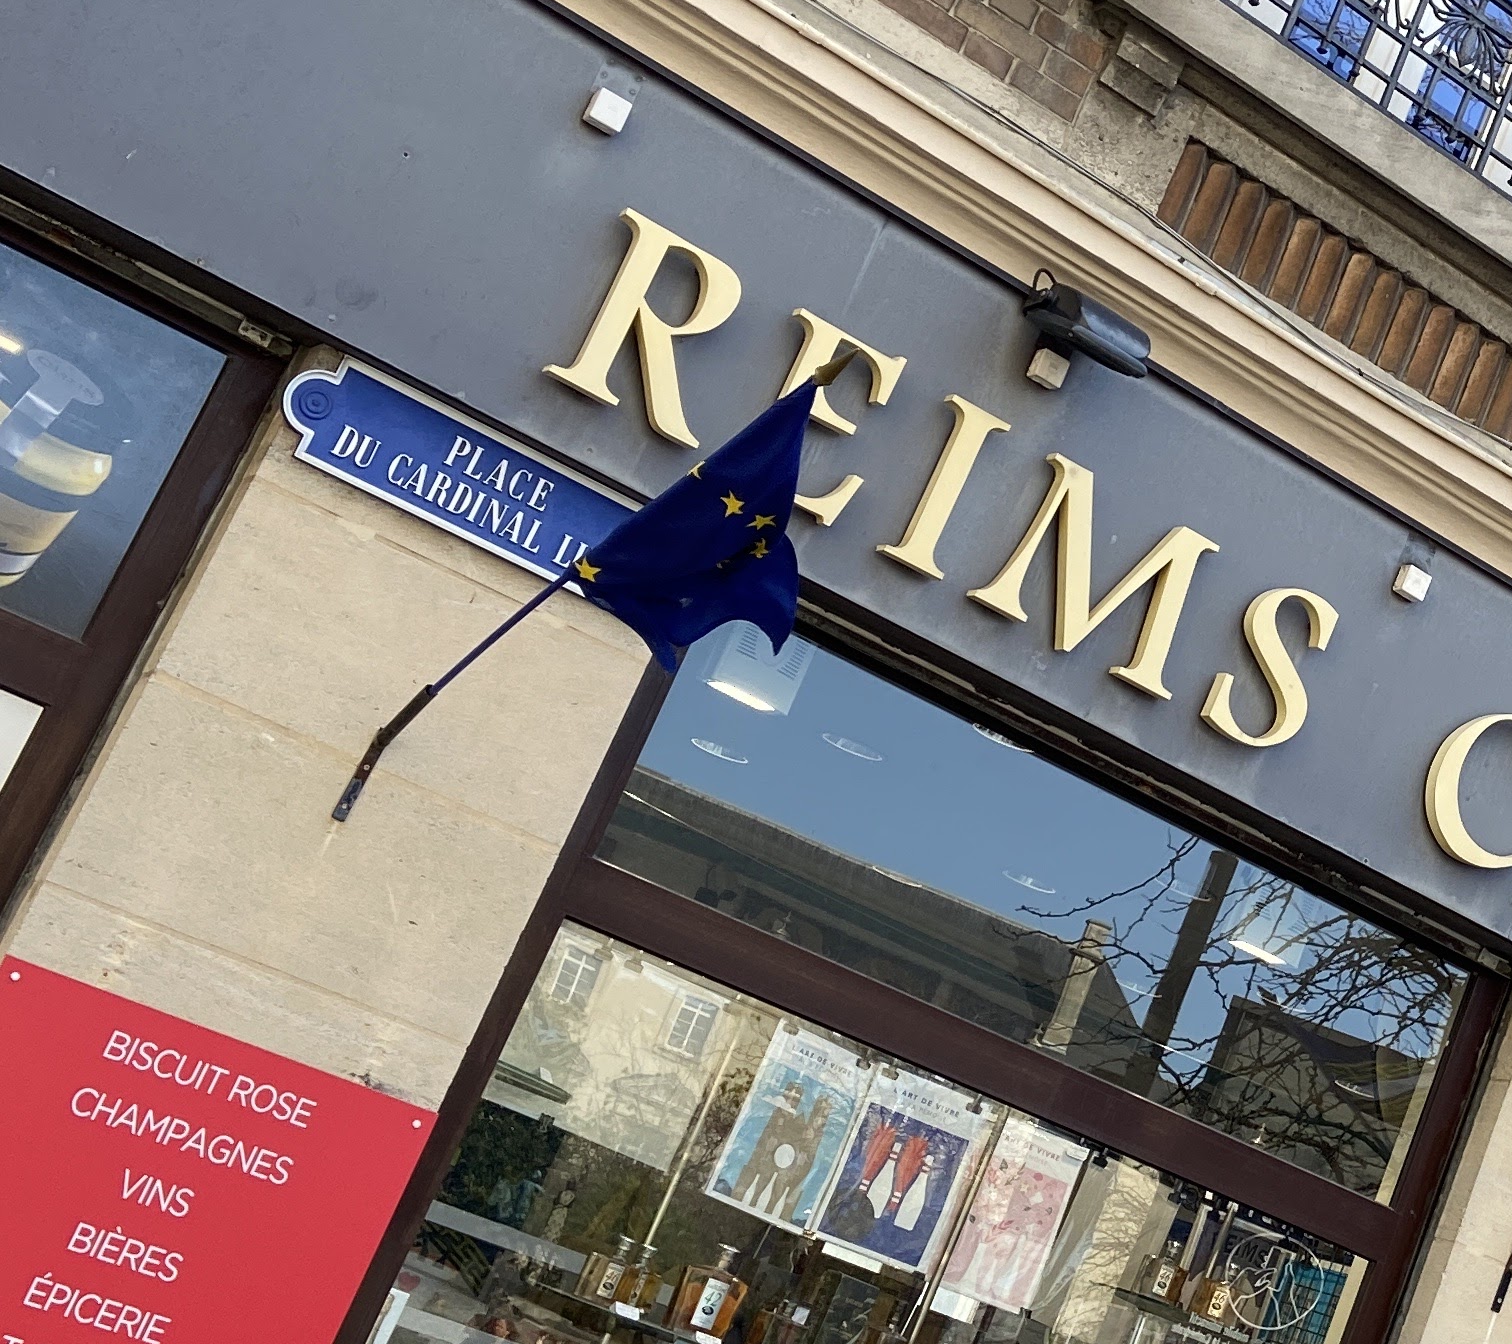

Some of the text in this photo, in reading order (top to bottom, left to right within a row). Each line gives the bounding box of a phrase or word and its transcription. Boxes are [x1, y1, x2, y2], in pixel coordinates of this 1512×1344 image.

[330, 424, 382, 468] DU
[387, 453, 543, 553] CARDINAL
[443, 435, 555, 512] PLACE
[542, 207, 1339, 747] REIMS
[102, 1030, 318, 1128] BISCUIT ROSE
[71, 1087, 294, 1185] CHAMPAGNES
[121, 1168, 195, 1217] VINS
[67, 1222, 184, 1283] BIÈRES
[704, 1289, 723, 1307] 42
